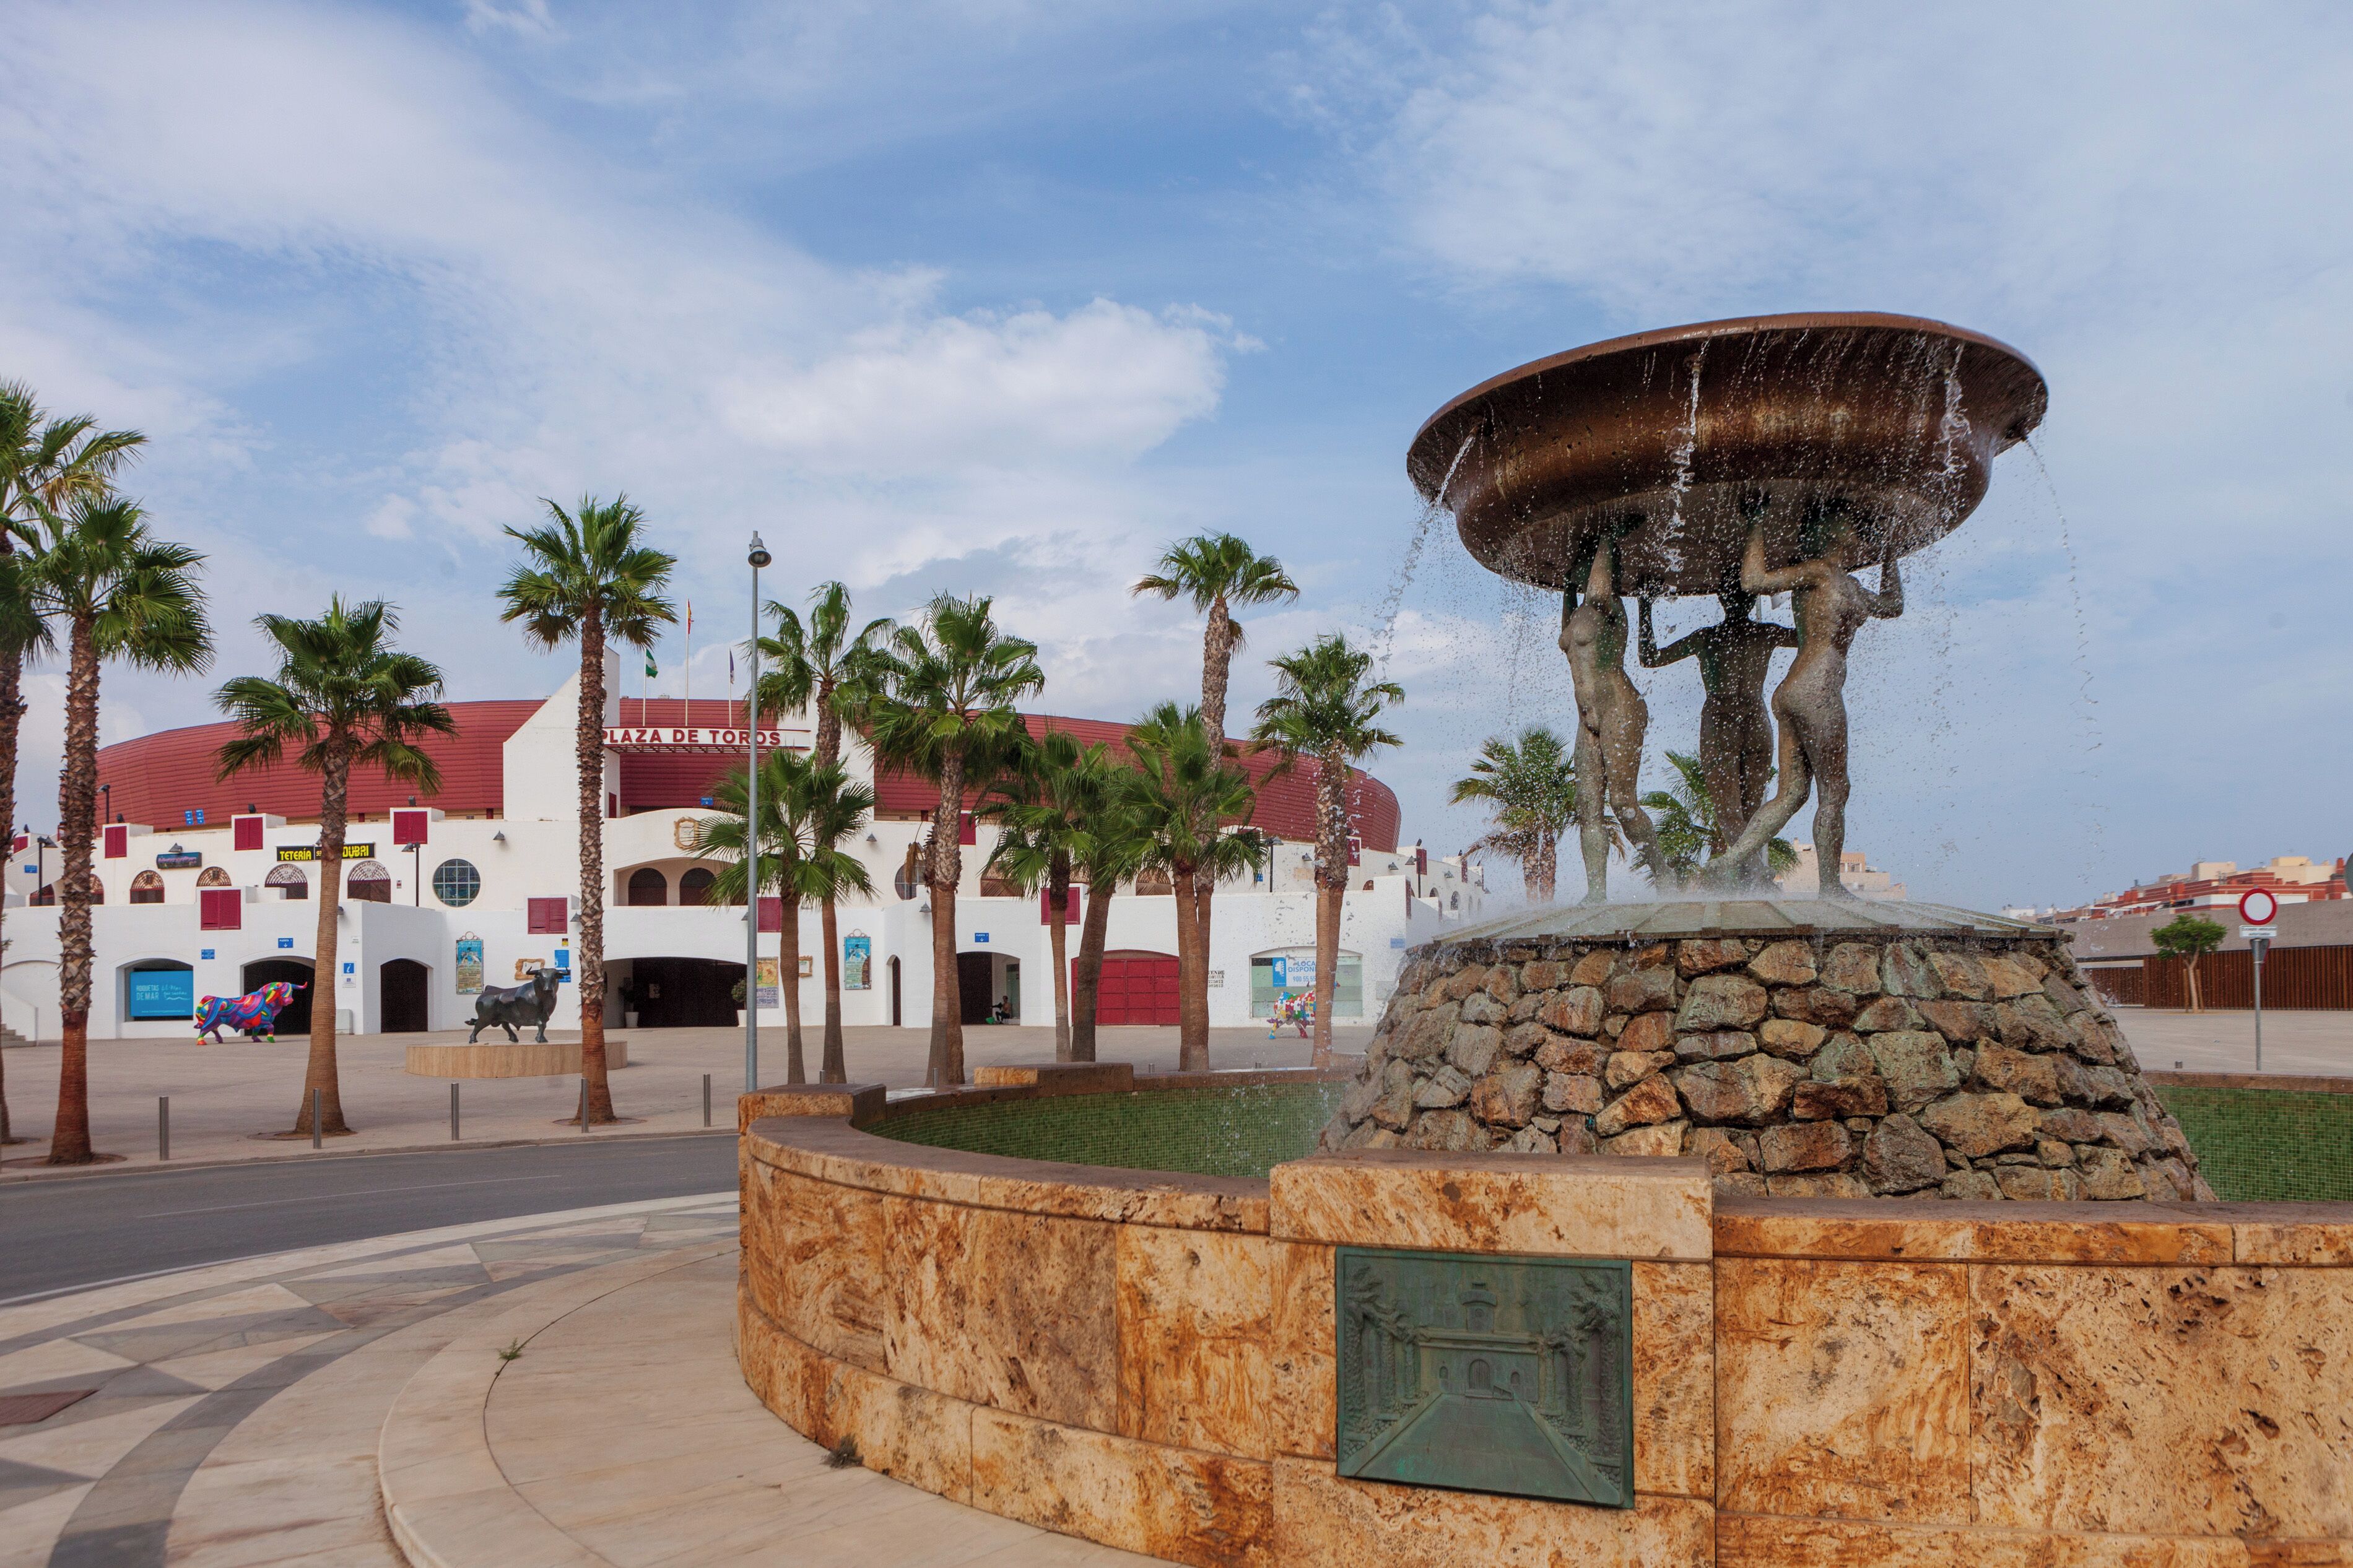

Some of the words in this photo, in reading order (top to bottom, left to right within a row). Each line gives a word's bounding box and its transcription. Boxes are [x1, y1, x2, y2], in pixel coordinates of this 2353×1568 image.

[673, 729, 698, 743] DE
[710, 730, 780, 745] TOROS
[280, 848, 311, 860] TETERÍA
[136, 992, 144, 1000] DE
[145, 992, 159, 1000] MAR
